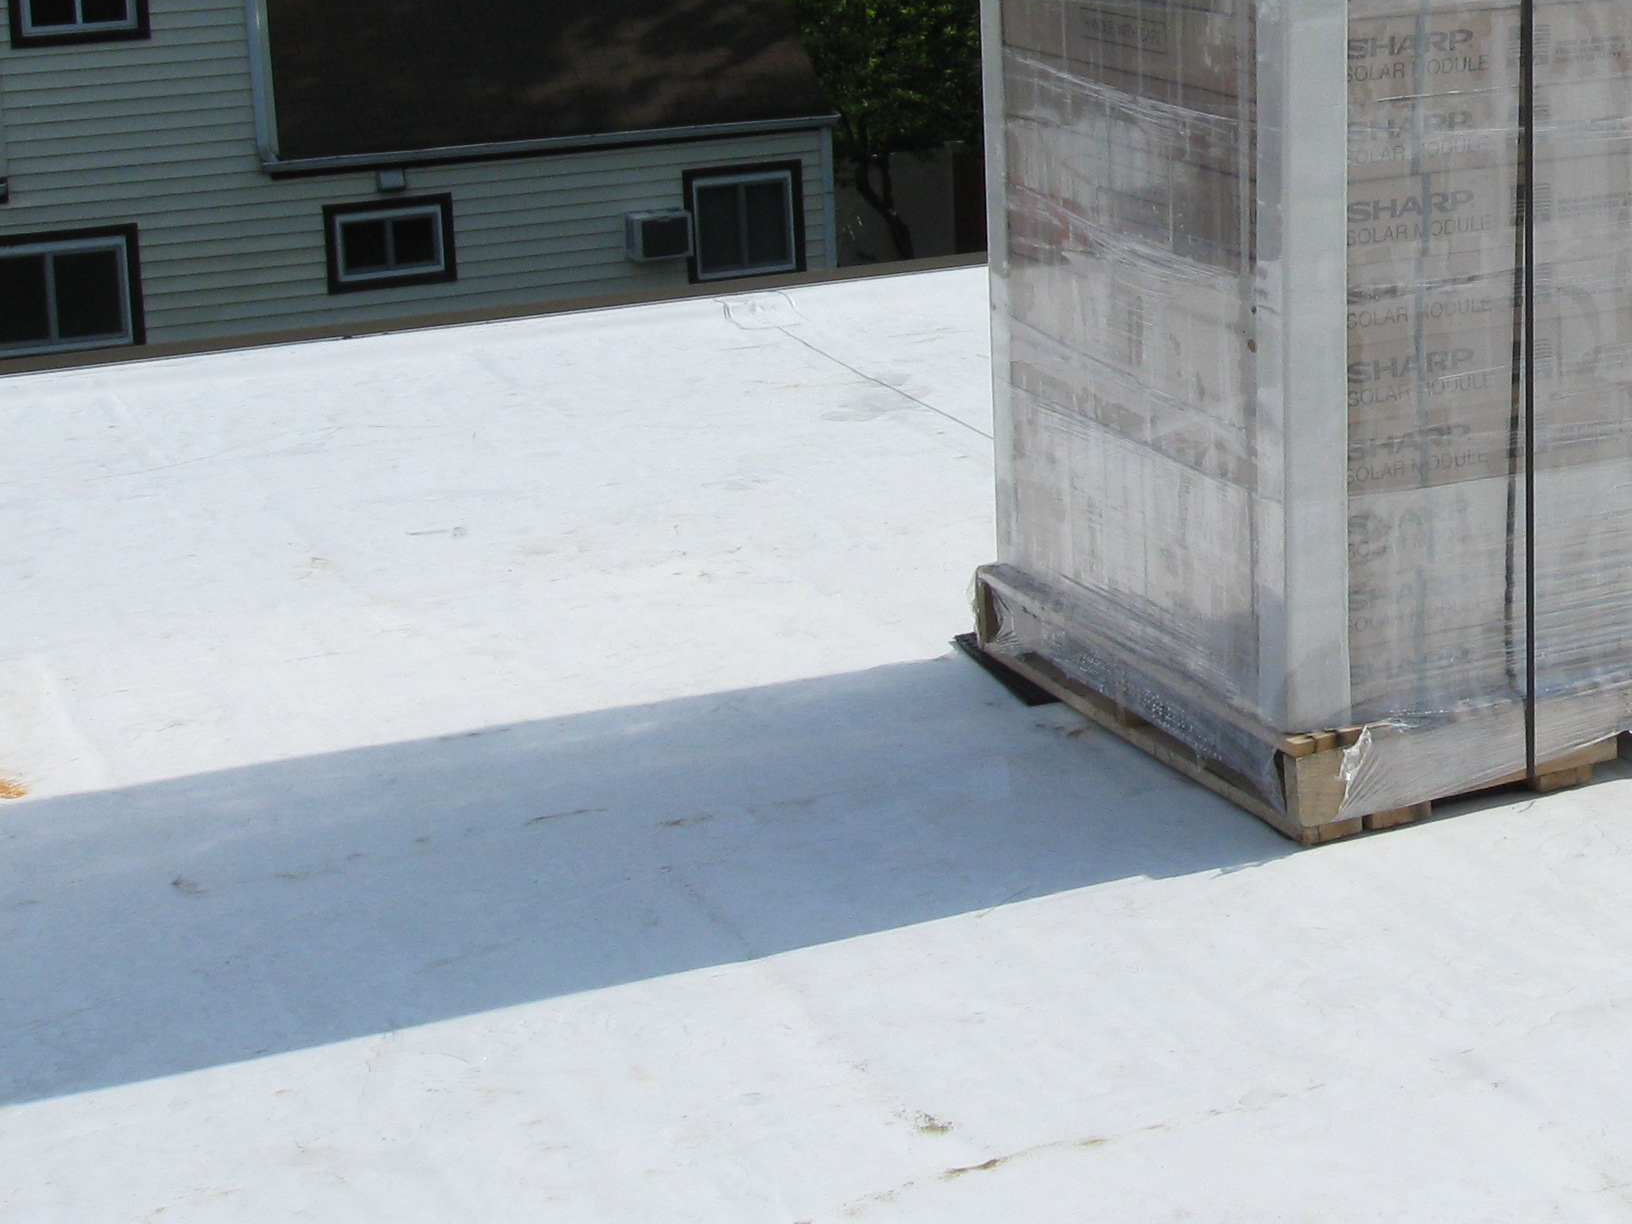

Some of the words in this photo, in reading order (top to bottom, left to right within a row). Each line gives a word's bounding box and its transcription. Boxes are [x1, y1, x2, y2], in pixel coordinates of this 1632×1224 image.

[1347, 29, 1475, 59] SHARP
[1347, 62, 1406, 83] SOLAR
[1413, 56, 1490, 76] ODULE
[1347, 111, 1472, 141] SHARP
[1347, 145, 1406, 165] SOLAR
[1414, 137, 1490, 158] ODULE
[1347, 189, 1475, 222] SHARP
[1347, 224, 1409, 245] SOLAR
[1347, 308, 1408, 330] SOLAR
[1347, 347, 1476, 384] SHARP
[1347, 383, 1410, 408] SOLAR
[1347, 424, 1471, 462] SHARP
[1347, 462, 1405, 485] SOLAR
